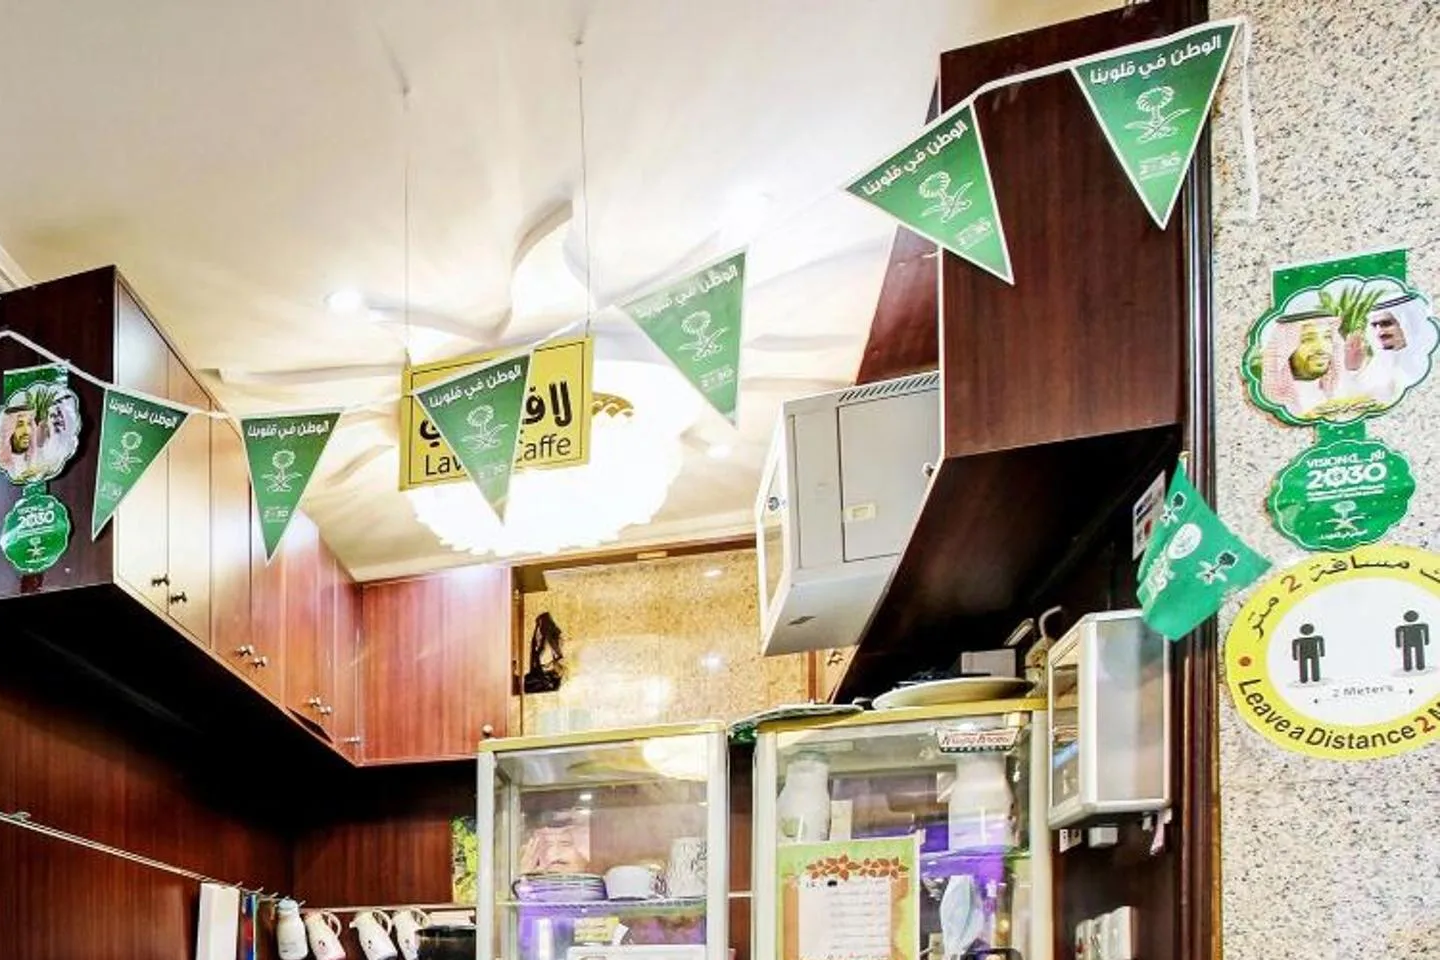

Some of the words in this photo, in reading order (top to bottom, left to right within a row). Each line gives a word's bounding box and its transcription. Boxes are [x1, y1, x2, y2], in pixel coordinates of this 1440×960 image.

[1170, 34, 1222, 66] الوطن
[1089, 61, 1136, 85] قلوبنا
[1138, 54, 1167, 79] في
[926, 119, 968, 155] الوطن
[903, 149, 926, 175] في
[861, 165, 901, 195] قلوبنا
[464, 378, 484, 400] في
[486, 364, 521, 389] الوطن
[297, 420, 329, 437] الوطن
[1305, 462, 1388, 490] 2030
[1310, 554, 1410, 582] مسافة
[1280, 574, 1303, 594] 2
[1247, 596, 1280, 641] متر
[1238, 678, 1291, 733] Leave
[1288, 728, 1306, 742] a
[1305, 724, 1417, 750] Distance
[1413, 715, 1437, 735] 2
